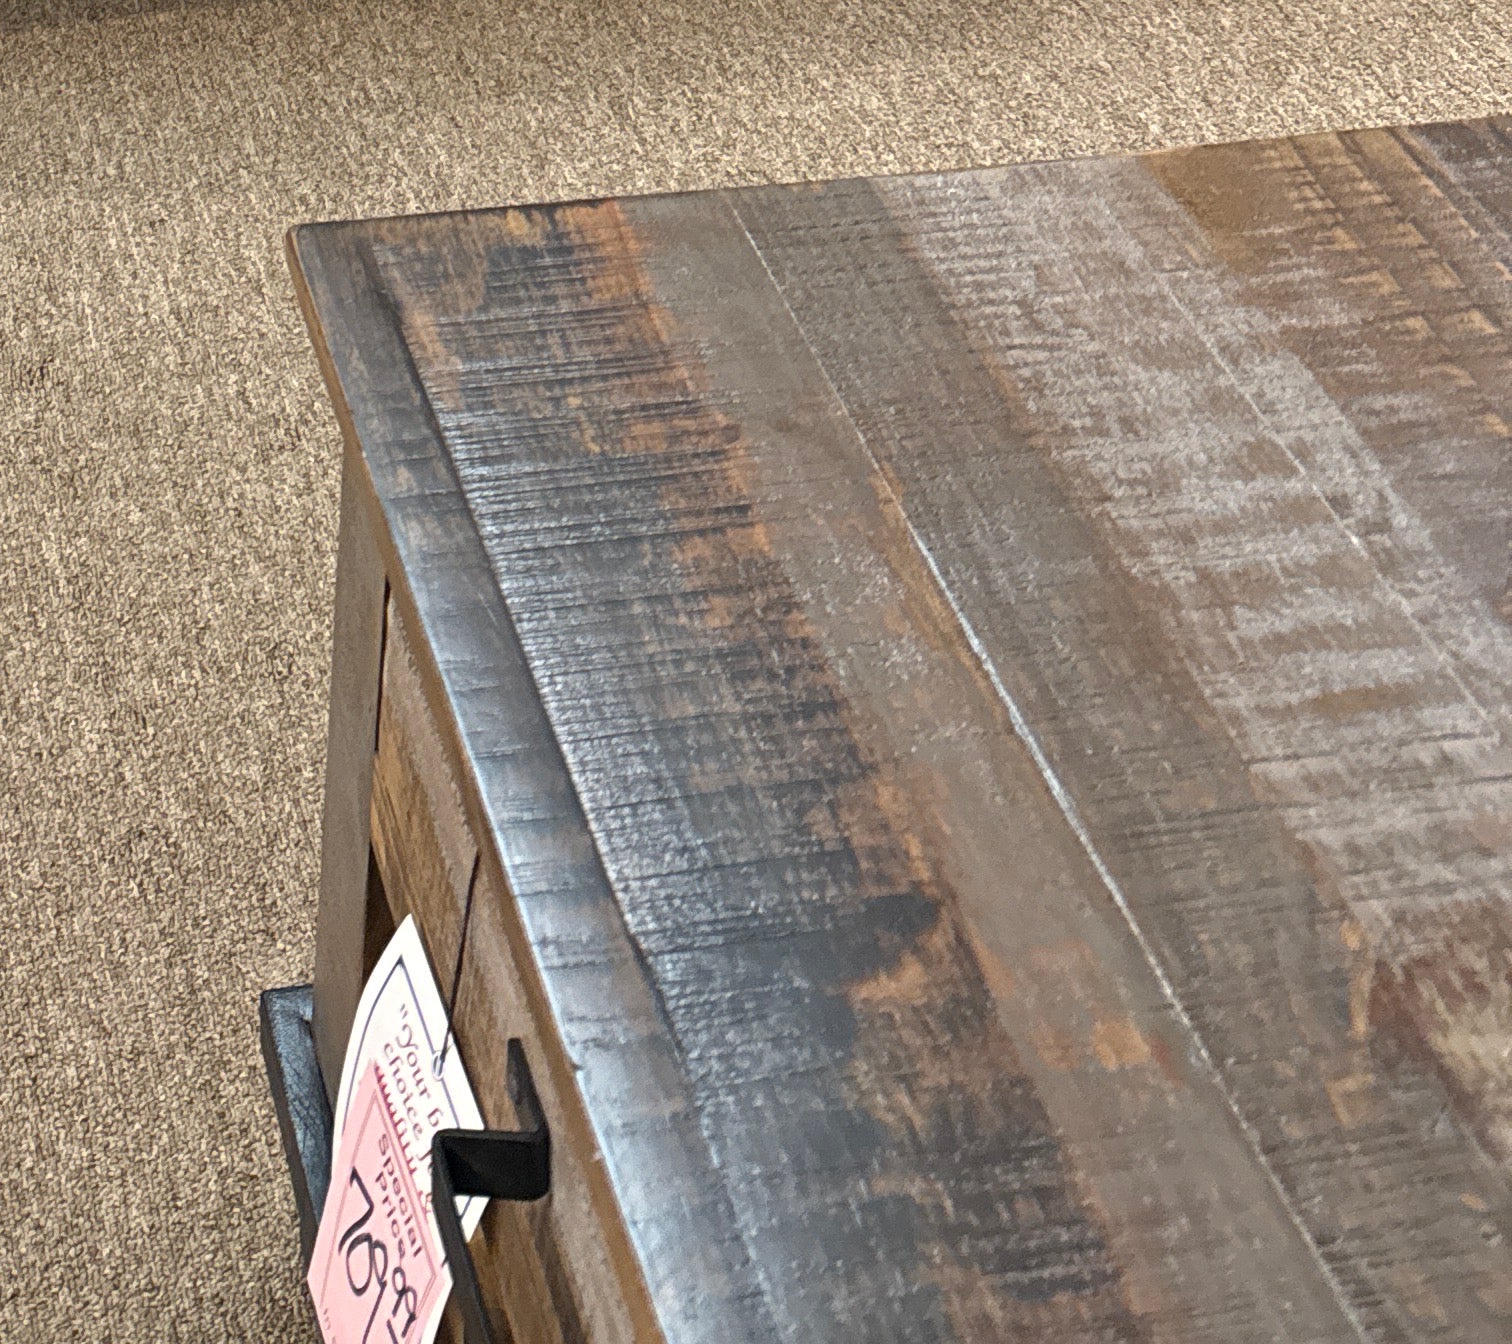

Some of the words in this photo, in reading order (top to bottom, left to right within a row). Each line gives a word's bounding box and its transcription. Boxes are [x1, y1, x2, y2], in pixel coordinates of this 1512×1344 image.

[383, 1042, 424, 1142] choice
[374, 1171, 406, 1261] Price
[378, 1133, 423, 1258] Special
